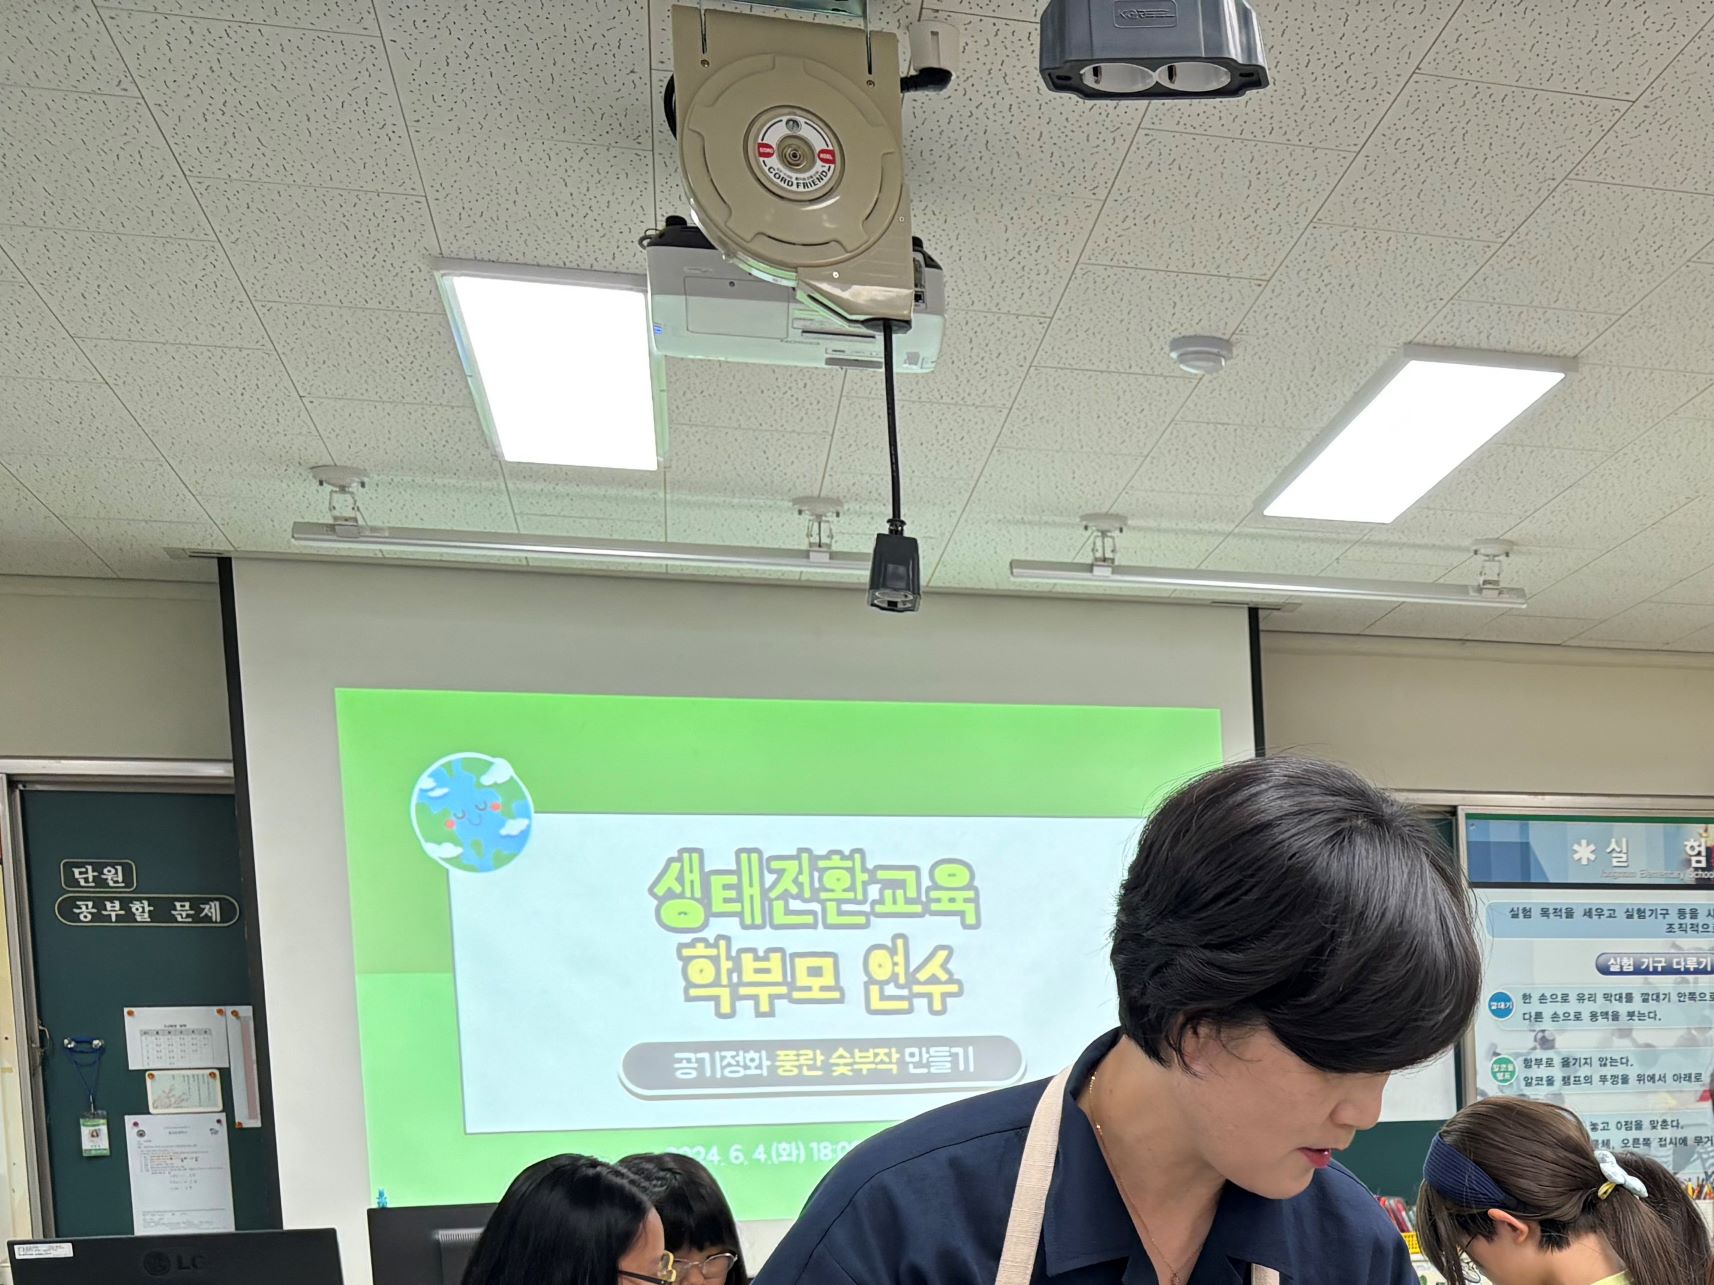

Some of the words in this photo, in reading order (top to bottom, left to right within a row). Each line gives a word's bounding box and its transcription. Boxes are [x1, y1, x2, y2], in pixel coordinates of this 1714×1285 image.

[768, 166, 794, 188] CORD
[796, 170, 828, 190] FRIEND
[71, 864, 126, 887] 단원
[650, 848, 981, 933] 생태전환교육
[72, 900, 155, 923] 공부할
[170, 900, 221, 923] 문제
[1508, 906, 1533, 919] 실험
[1539, 906, 1575, 920] 목적을
[1582, 907, 1617, 920] 세우고
[1623, 907, 1671, 920] 실험기구
[1677, 907, 1699, 920] 등을
[1607, 956, 1634, 971] 실험
[1640, 956, 1668, 971] 기구
[1672, 956, 1712, 971] 다루기
[677, 934, 845, 1018] 학부모
[863, 933, 964, 1016] 연수
[1521, 992, 1532, 1004] 한
[1538, 992, 1571, 1004] 손으로
[1576, 992, 1597, 1004] 유리
[1602, 991, 1634, 1003] 막대를
[1522, 1011, 1544, 1023] 다른
[1550, 1011, 1584, 1023] 손으로
[673, 1050, 771, 1080] 공기정화
[775, 1048, 825, 1076] 풍란
[829, 1047, 900, 1075] 숯부작
[904, 1045, 975, 1074] 만들기
[1523, 1057, 1556, 1069] 함부로
[1598, 1055, 1634, 1067] 않는다.
[1636, 1072, 1667, 1084] 위에서
[1672, 1072, 1704, 1084] 아래로
[1657, 1136, 1689, 1148] 접시에
[728, 1144, 748, 1165] 6.
[752, 1141, 806, 1165] 4.(화)
